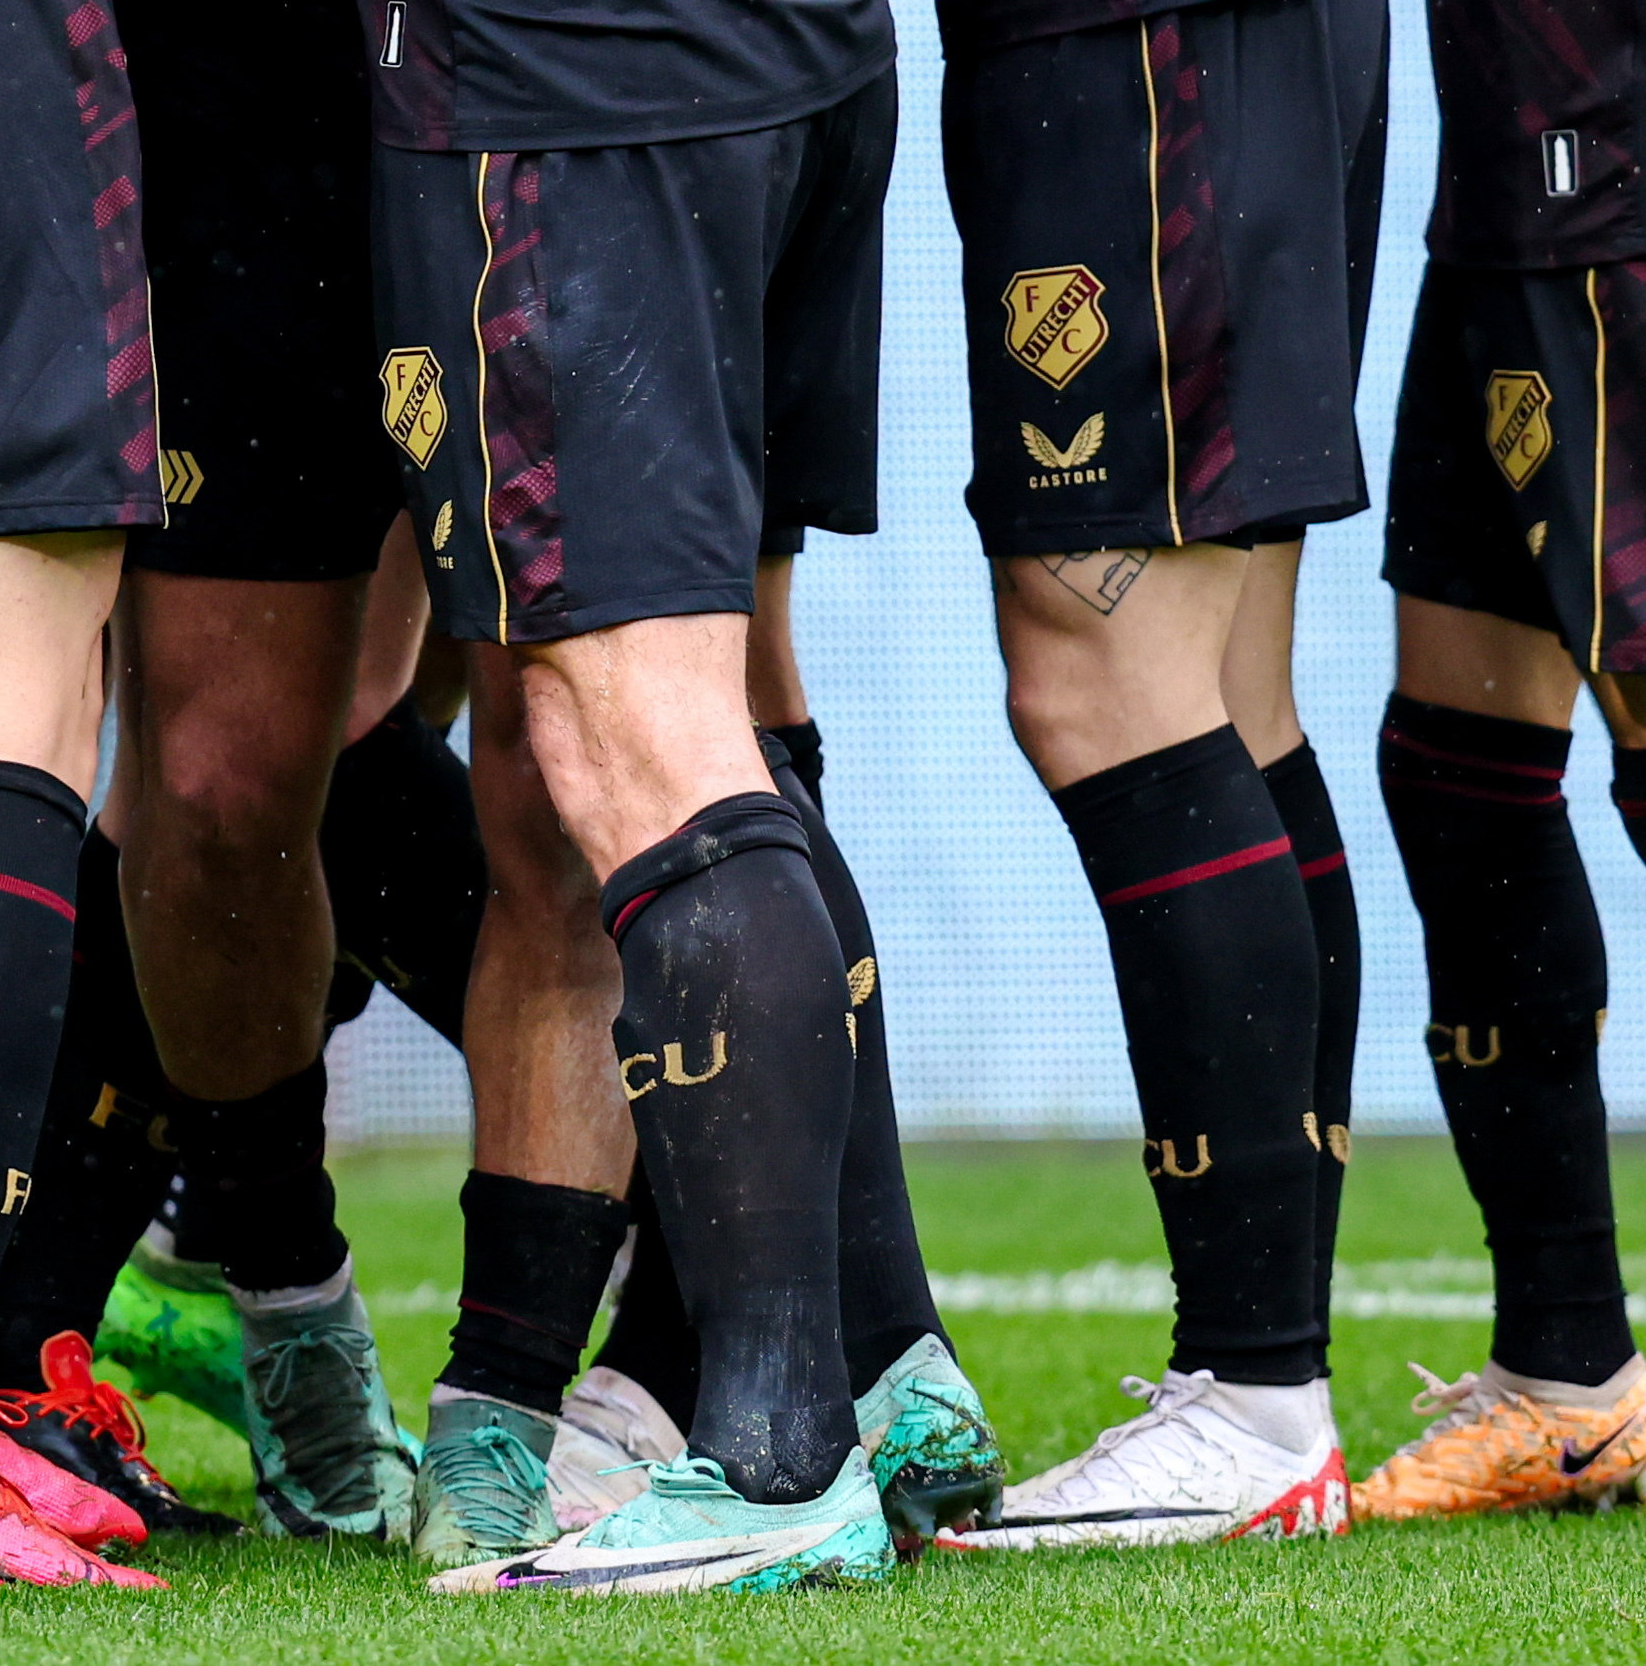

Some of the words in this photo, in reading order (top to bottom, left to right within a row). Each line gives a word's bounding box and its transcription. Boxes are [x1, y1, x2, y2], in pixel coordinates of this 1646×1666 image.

[1025, 285, 1039, 313] F
[1022, 275, 1090, 366] UTRECHT
[1061, 329, 1082, 354] C
[396, 364, 407, 390] F
[394, 357, 434, 442] UTRECHT
[1499, 385, 1507, 411] F
[420, 411, 434, 436] C
[1521, 433, 1534, 459] C
[1029, 467, 1108, 489] CASTORE
[1424, 1022, 1501, 1067] CU
[619, 1032, 727, 1101] CU
[1144, 1134, 1213, 1178] CU
